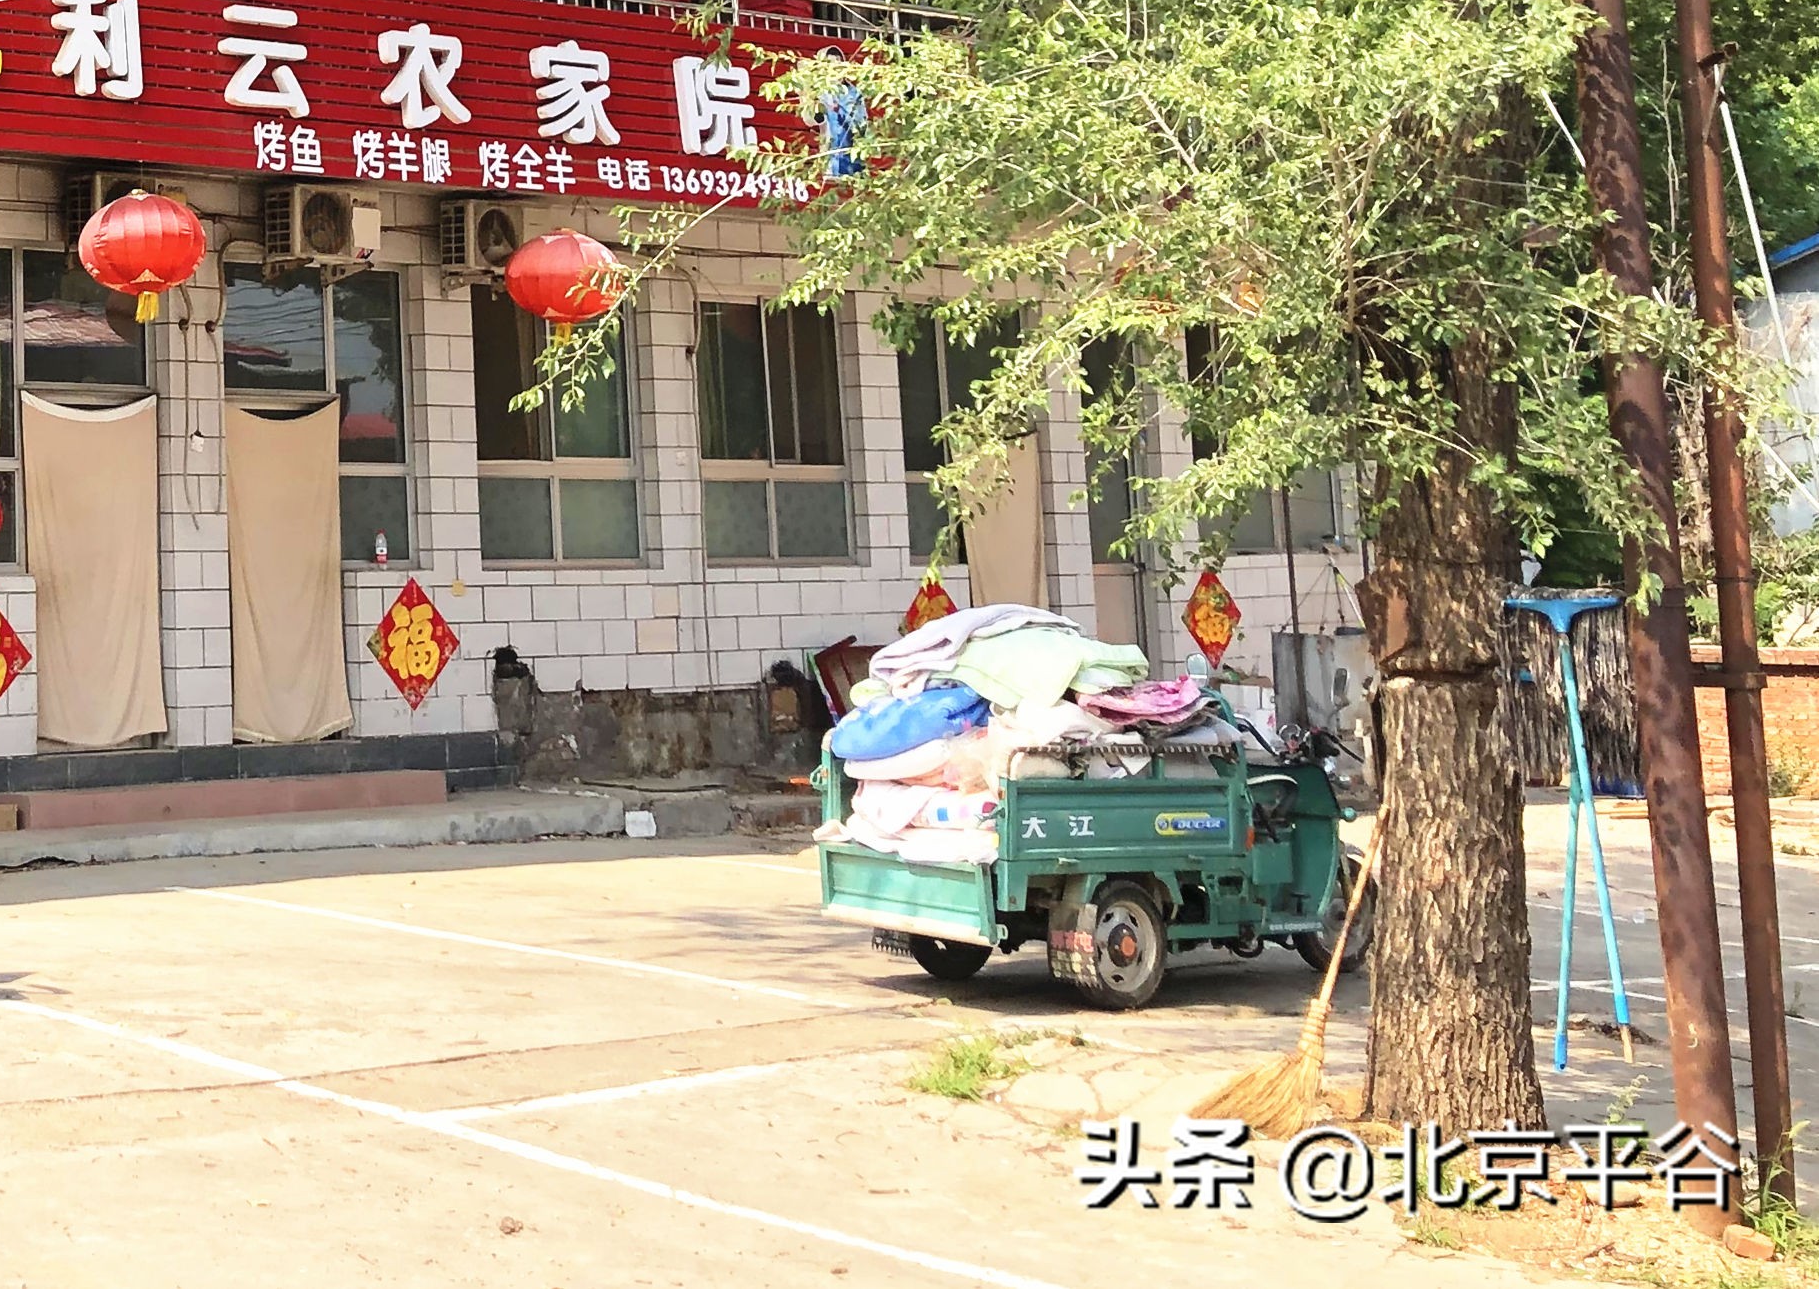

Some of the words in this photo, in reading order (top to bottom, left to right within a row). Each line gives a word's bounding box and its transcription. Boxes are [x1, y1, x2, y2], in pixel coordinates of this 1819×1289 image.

[253, 120, 325, 174] 烤鱼
[352, 129, 452, 184] 烤羊腿
[478, 140, 577, 195] 烤全羊
[597, 155, 651, 192] 电话
[388, 602, 441, 680] 福
[1021, 815, 1095, 839] 大江
